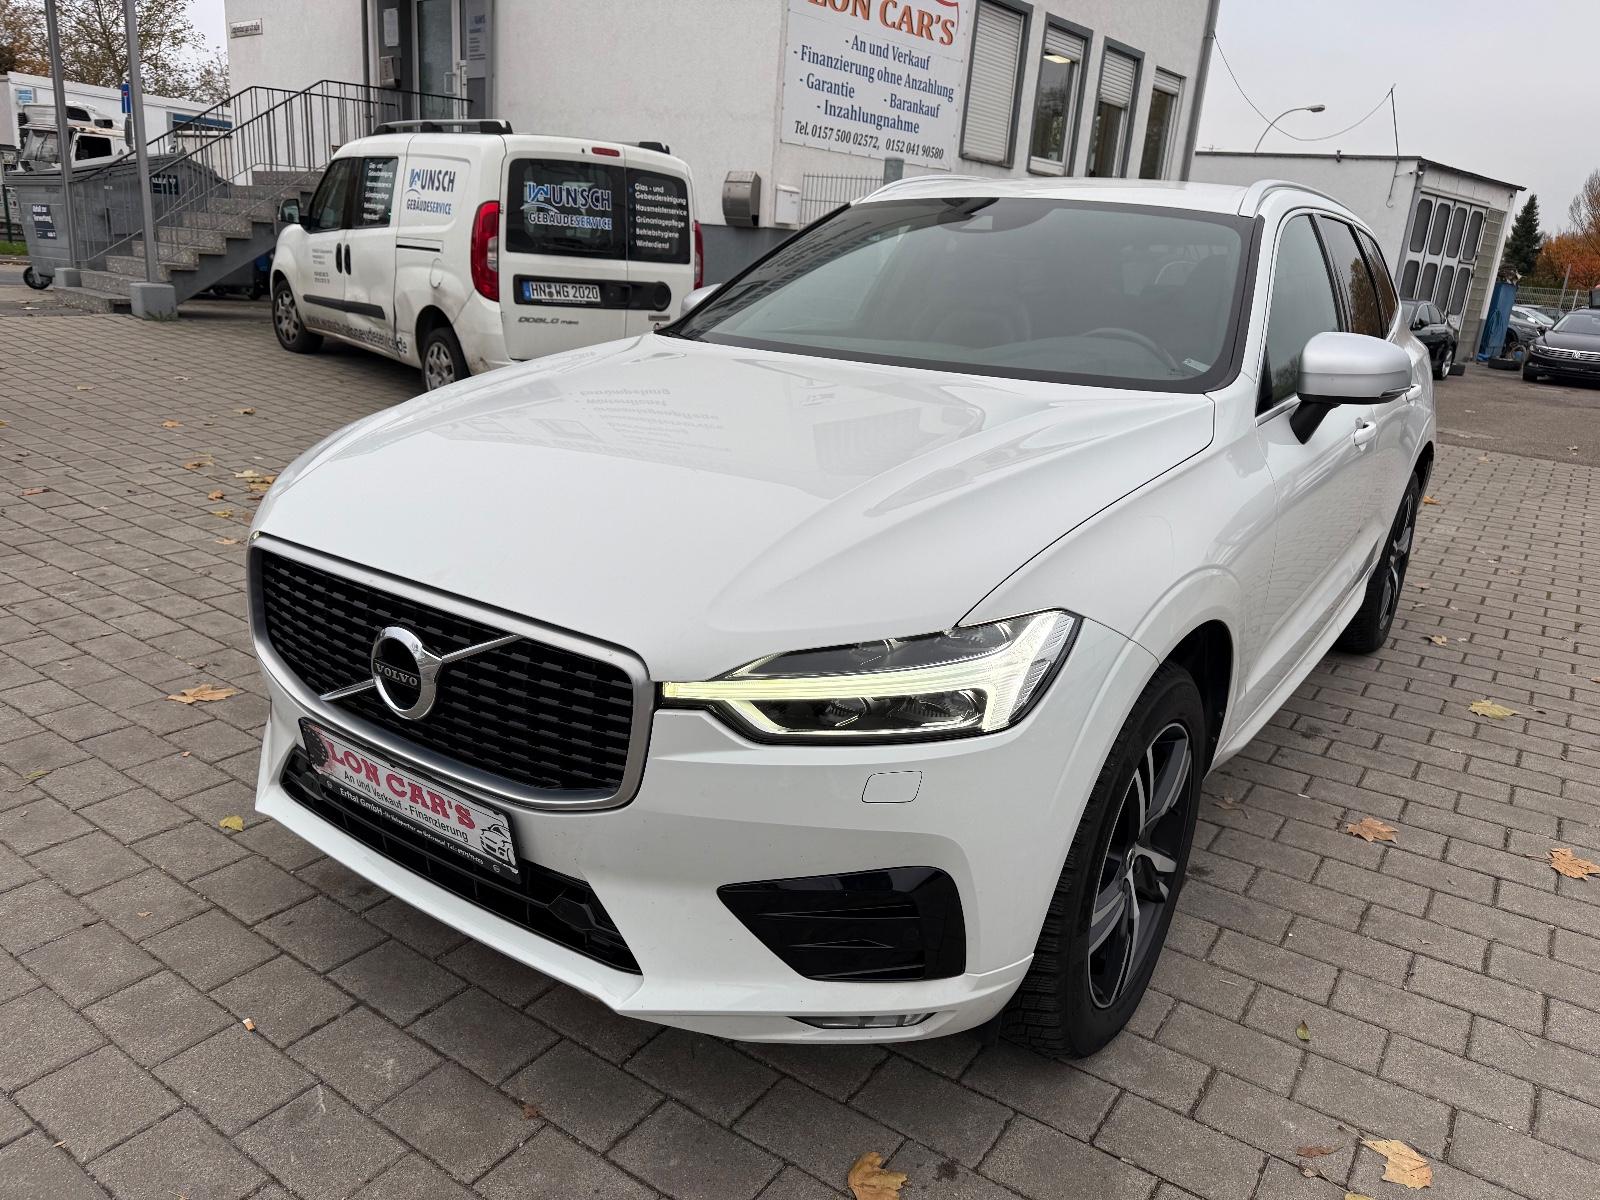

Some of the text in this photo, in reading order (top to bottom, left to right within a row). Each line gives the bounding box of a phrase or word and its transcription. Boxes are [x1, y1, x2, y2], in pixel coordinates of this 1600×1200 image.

[879, 0, 955, 46] CAR'S
[851, 35, 931, 70] An und Verkauf
[800, 44, 954, 102] Finanzierung ohne Anzahlung
[806, 73, 855, 98] Garantie
[824, 99, 920, 134] Inzahlungnahme
[890, 93, 941, 118] Barankauf
[795, 120, 809, 136] Tel.
[811, 124, 833, 141] 0157
[835, 130, 851, 144] 500
[885, 138, 904, 153] 0152
[906, 142, 920, 156] 041
[921, 145, 943, 160] 90580
[408, 168, 456, 192] WUNSCH
[406, 197, 452, 215] GEBÄUDESERVICE
[527, 182, 612, 211] WUNSCH
[528, 211, 612, 230] GEBÄUDESERVICE
[531, 282, 599, 300] HN WG 2020
[375, 663, 418, 686] VOLVO
[325, 739, 380, 787] LON
[386, 773, 476, 830] CAR'S
[344, 770, 355, 784] An
[356, 779, 371, 793] und
[372, 785, 402, 810] Verkauf
[409, 804, 469, 843] Finanzierung
